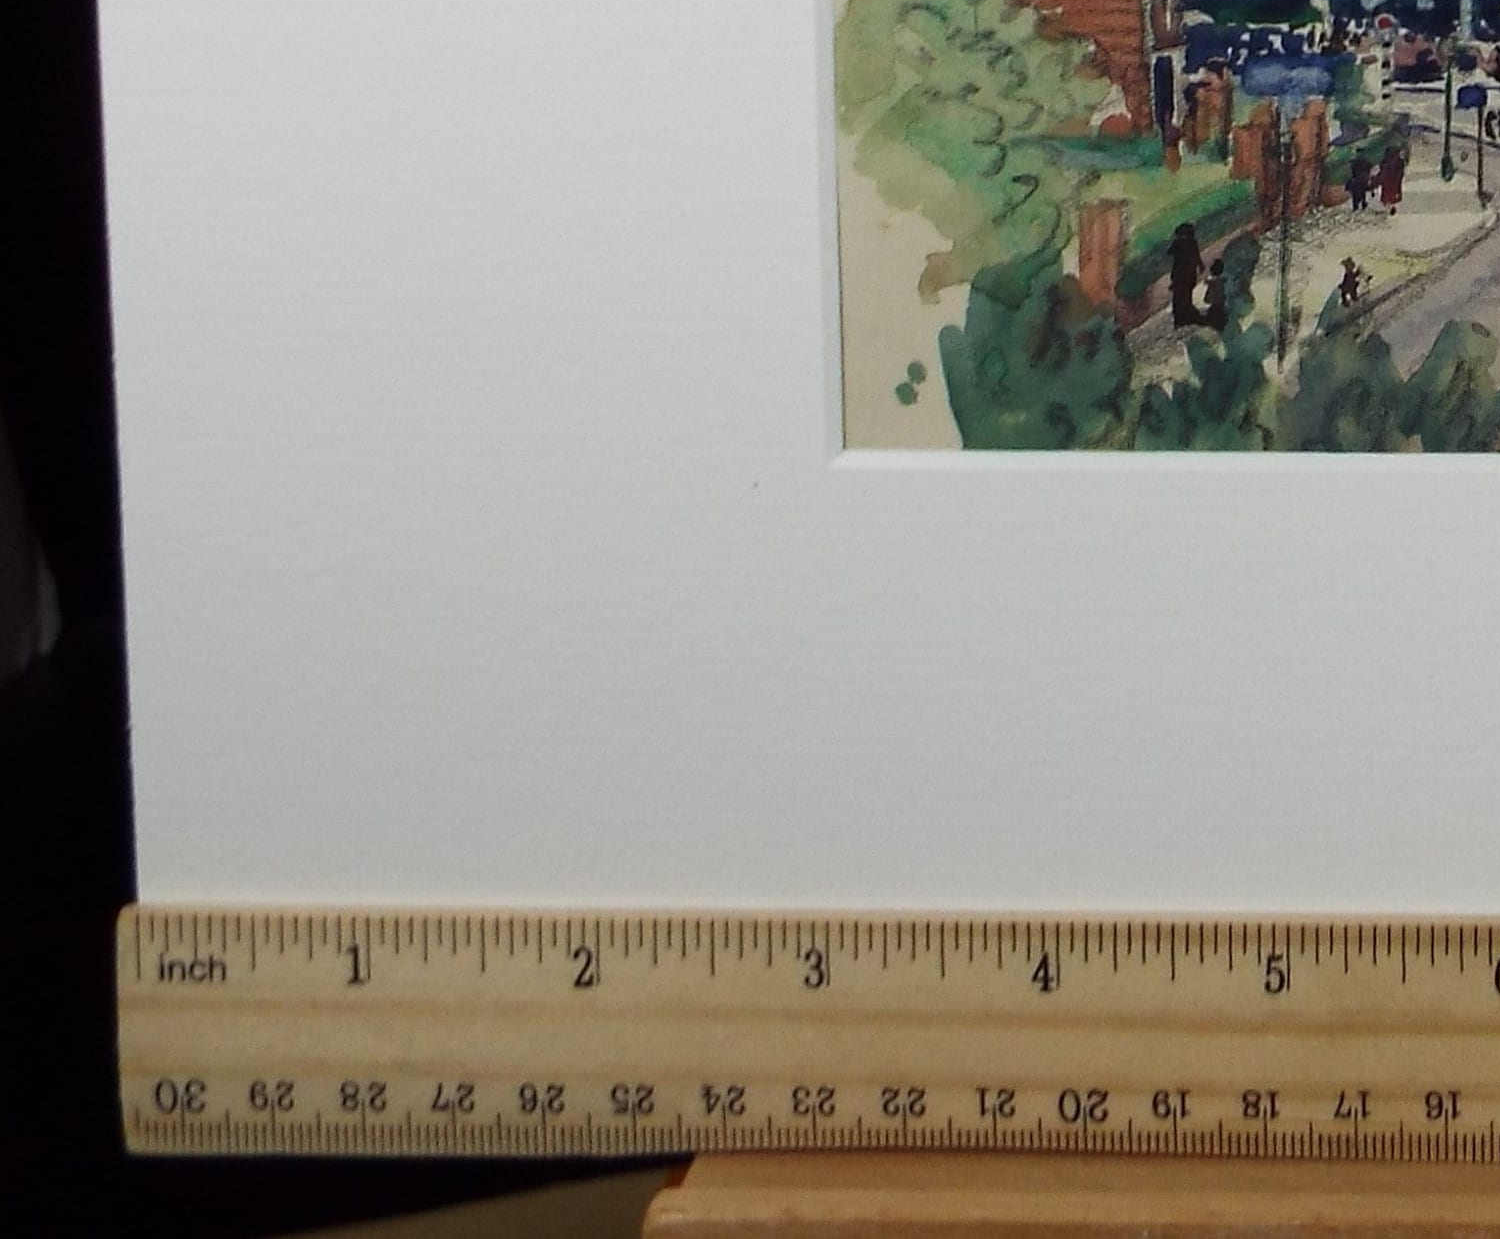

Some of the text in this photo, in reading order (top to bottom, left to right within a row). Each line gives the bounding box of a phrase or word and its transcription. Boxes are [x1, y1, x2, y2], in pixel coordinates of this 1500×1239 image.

[159, 952, 227, 982] inch
[346, 947, 365, 986] 1
[573, 949, 595, 987] 2
[804, 951, 827, 989] 3
[1032, 953, 1054, 993] 4
[1264, 955, 1286, 993] 5
[154, 1081, 206, 1114] 30
[249, 1082, 294, 1114] 29
[339, 1082, 387, 1113] 28
[430, 1084, 475, 1114] 27
[520, 1085, 565, 1115] 26
[611, 1085, 655, 1114] 25
[702, 1086, 745, 1116] 24
[792, 1086, 836, 1116] 23
[882, 1087, 926, 1117] 22
[975, 1088, 1015, 1118] 21
[1058, 1089, 1109, 1122] 20
[1152, 1090, 1190, 1121] 19
[1243, 1091, 1279, 1121] 18
[1334, 1091, 1370, 1121] 17
[1426, 1091, 1462, 1121] 16
